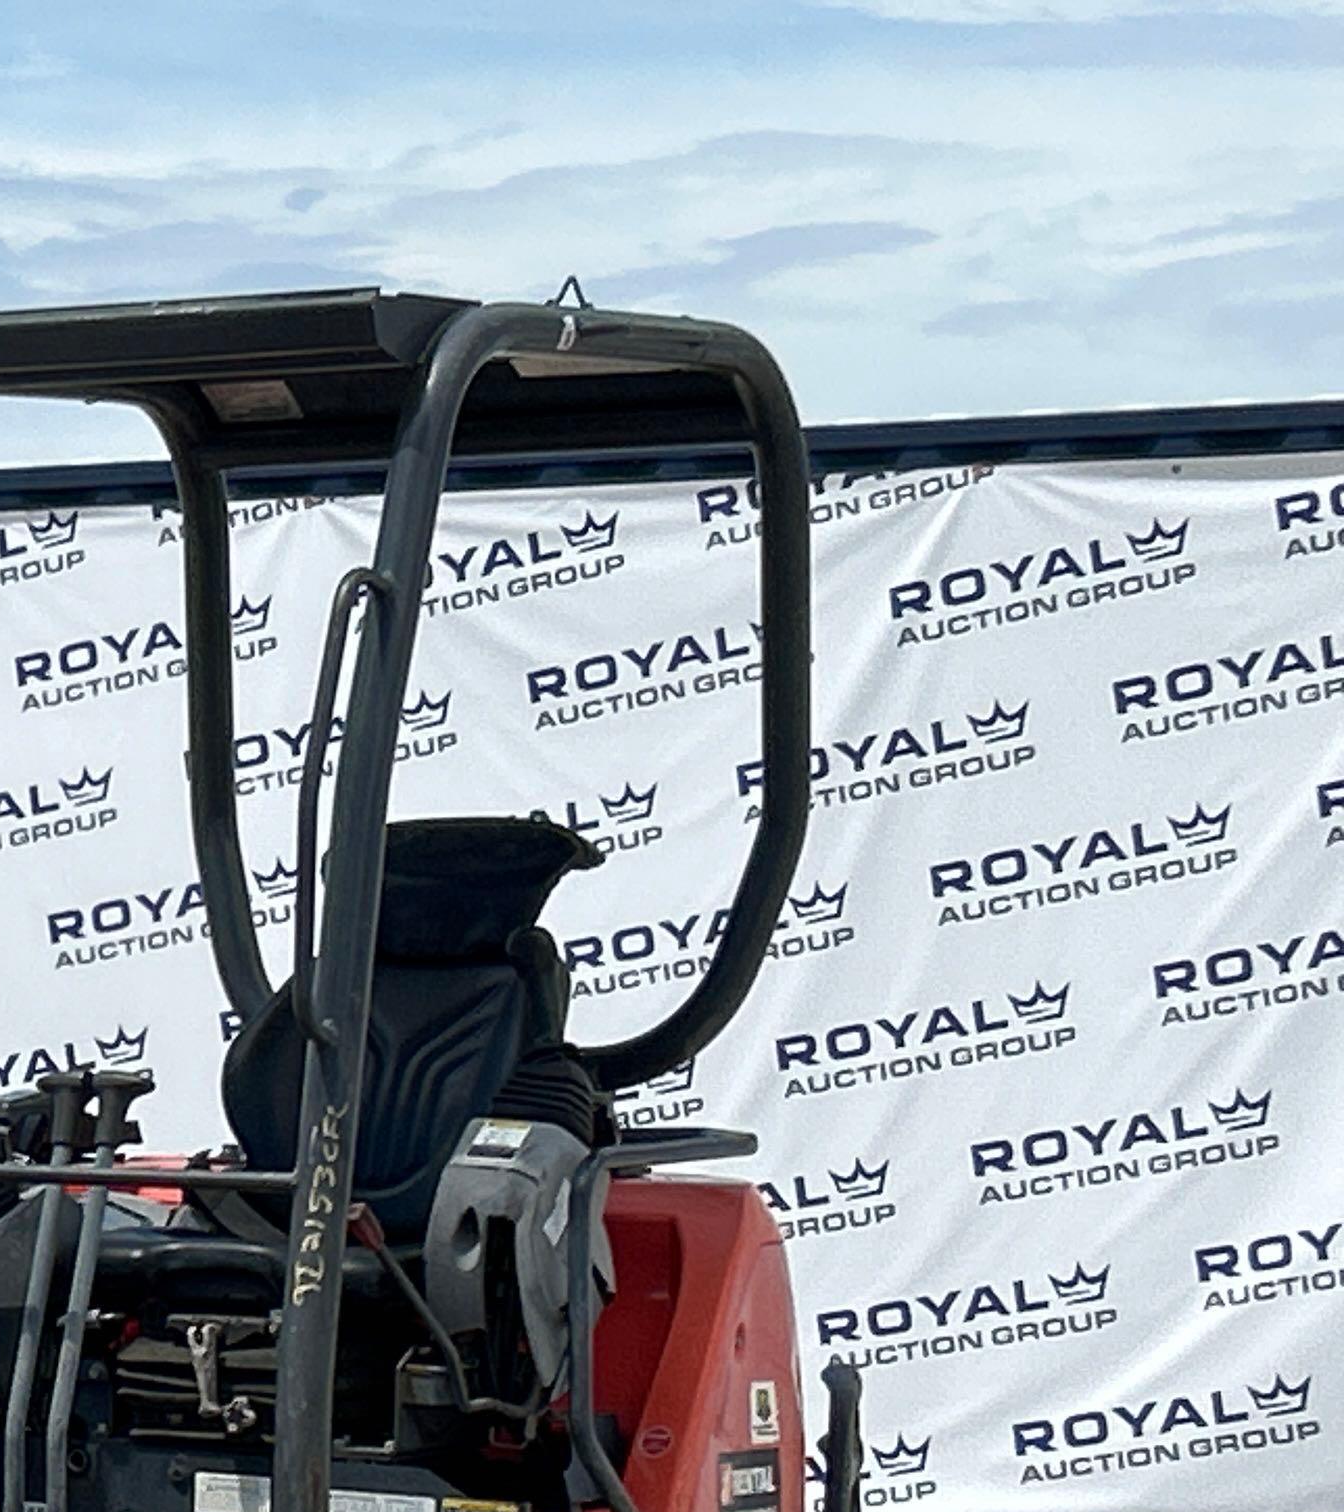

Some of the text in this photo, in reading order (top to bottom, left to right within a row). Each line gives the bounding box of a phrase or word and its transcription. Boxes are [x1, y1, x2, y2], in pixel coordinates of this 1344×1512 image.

[507, 555, 624, 597] GROUP
[889, 540, 1125, 619] ROYAL
[897, 563, 1196, 648] AUCTION GROUP
[15, 622, 182, 687] ROYA
[527, 627, 750, 704] ROYAL
[23, 665, 158, 712] AUCTION
[535, 680, 685, 731] AUCTION
[1122, 690, 1287, 743] AUCTION
[909, 746, 1035, 788] GROUP
[10, 809, 117, 846] GROUP
[930, 823, 1166, 898] ROYAL
[939, 849, 1237, 926] AUCTION GROUP
[56, 926, 193, 968] AUCTION
[1162, 974, 1327, 1027] AUCTION
[776, 1001, 1007, 1071] ROYAL
[785, 1027, 1075, 1098] AUCTION GROUP
[971, 1107, 1207, 1177] ROYAL
[980, 1135, 1279, 1205] AUCTION GROUP
[817, 1280, 1047, 1346] ROYAL
[991, 1309, 1117, 1345] GROUP
[1012, 1391, 1247, 1456] ROYAL
[1021, 1421, 1320, 1484] AUCTION GROUP
